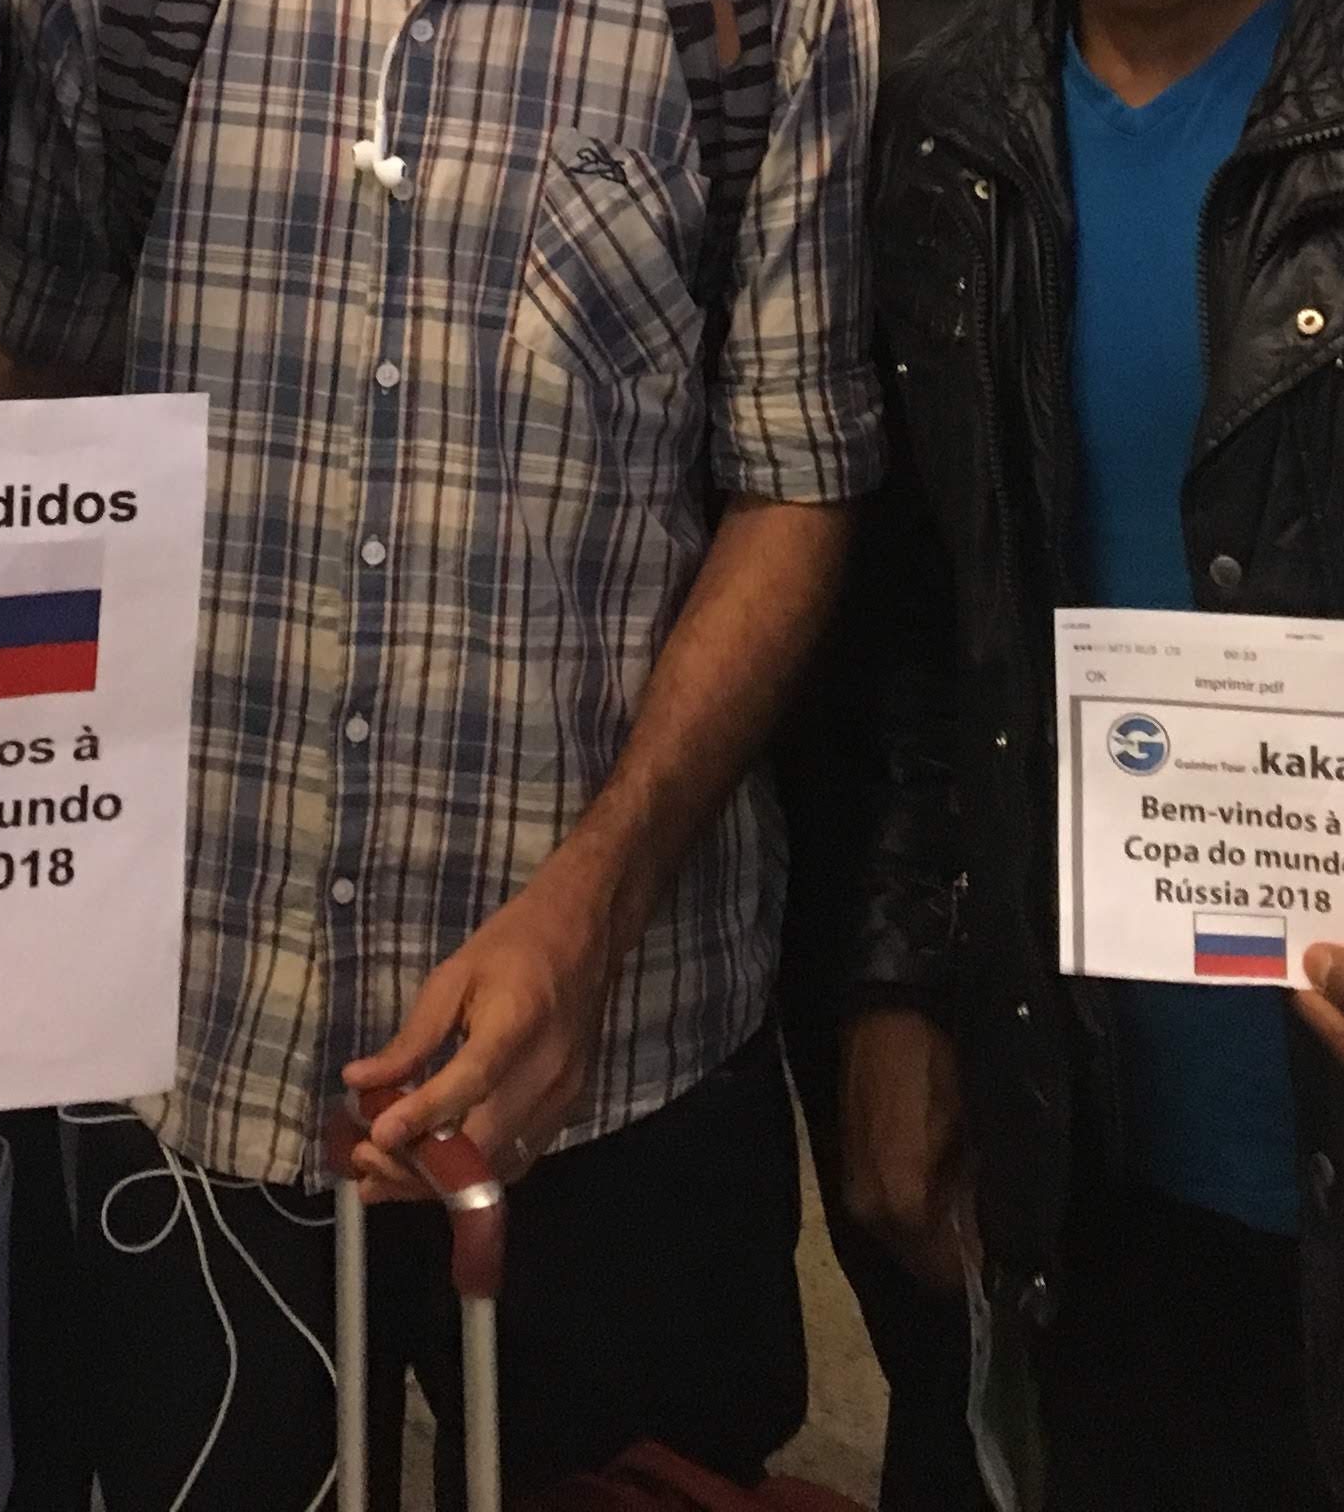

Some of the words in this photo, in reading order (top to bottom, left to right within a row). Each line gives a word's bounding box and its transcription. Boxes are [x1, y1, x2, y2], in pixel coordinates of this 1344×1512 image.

[73, 725, 99, 762] à
[1141, 795, 1318, 833] Bem-vindos
[1324, 809, 1342, 836] à
[1124, 835, 1200, 868] Copa
[1208, 839, 1246, 866] do
[1155, 877, 1250, 907] Rússia
[1259, 883, 1332, 914] 2018
